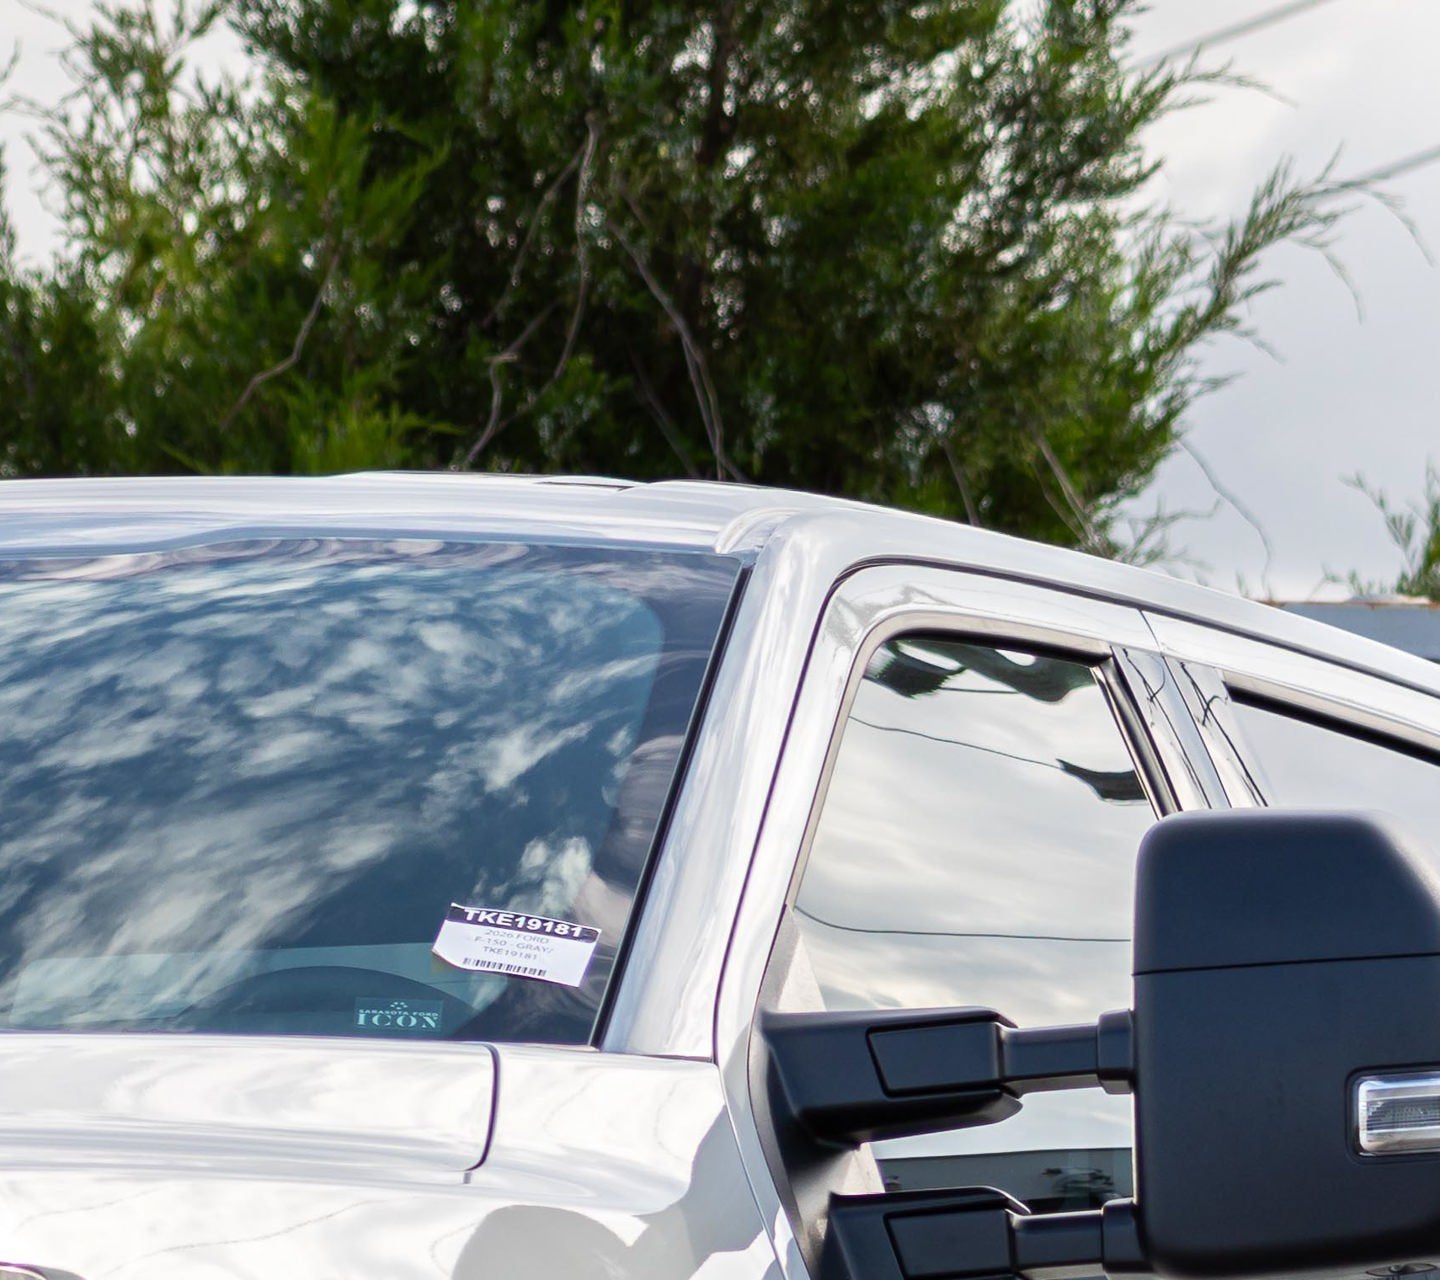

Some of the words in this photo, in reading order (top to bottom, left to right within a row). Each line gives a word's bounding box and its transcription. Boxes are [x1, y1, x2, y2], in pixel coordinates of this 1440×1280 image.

[463, 908, 582, 937] TKE19181
[474, 936, 507, 947] F-150
[484, 929, 514, 939] 2026
[515, 932, 550, 944] FORD
[482, 945, 538, 961] TKE19181
[358, 1008, 409, 1016] SARASOTA
[357, 1013, 438, 1029] ICON
